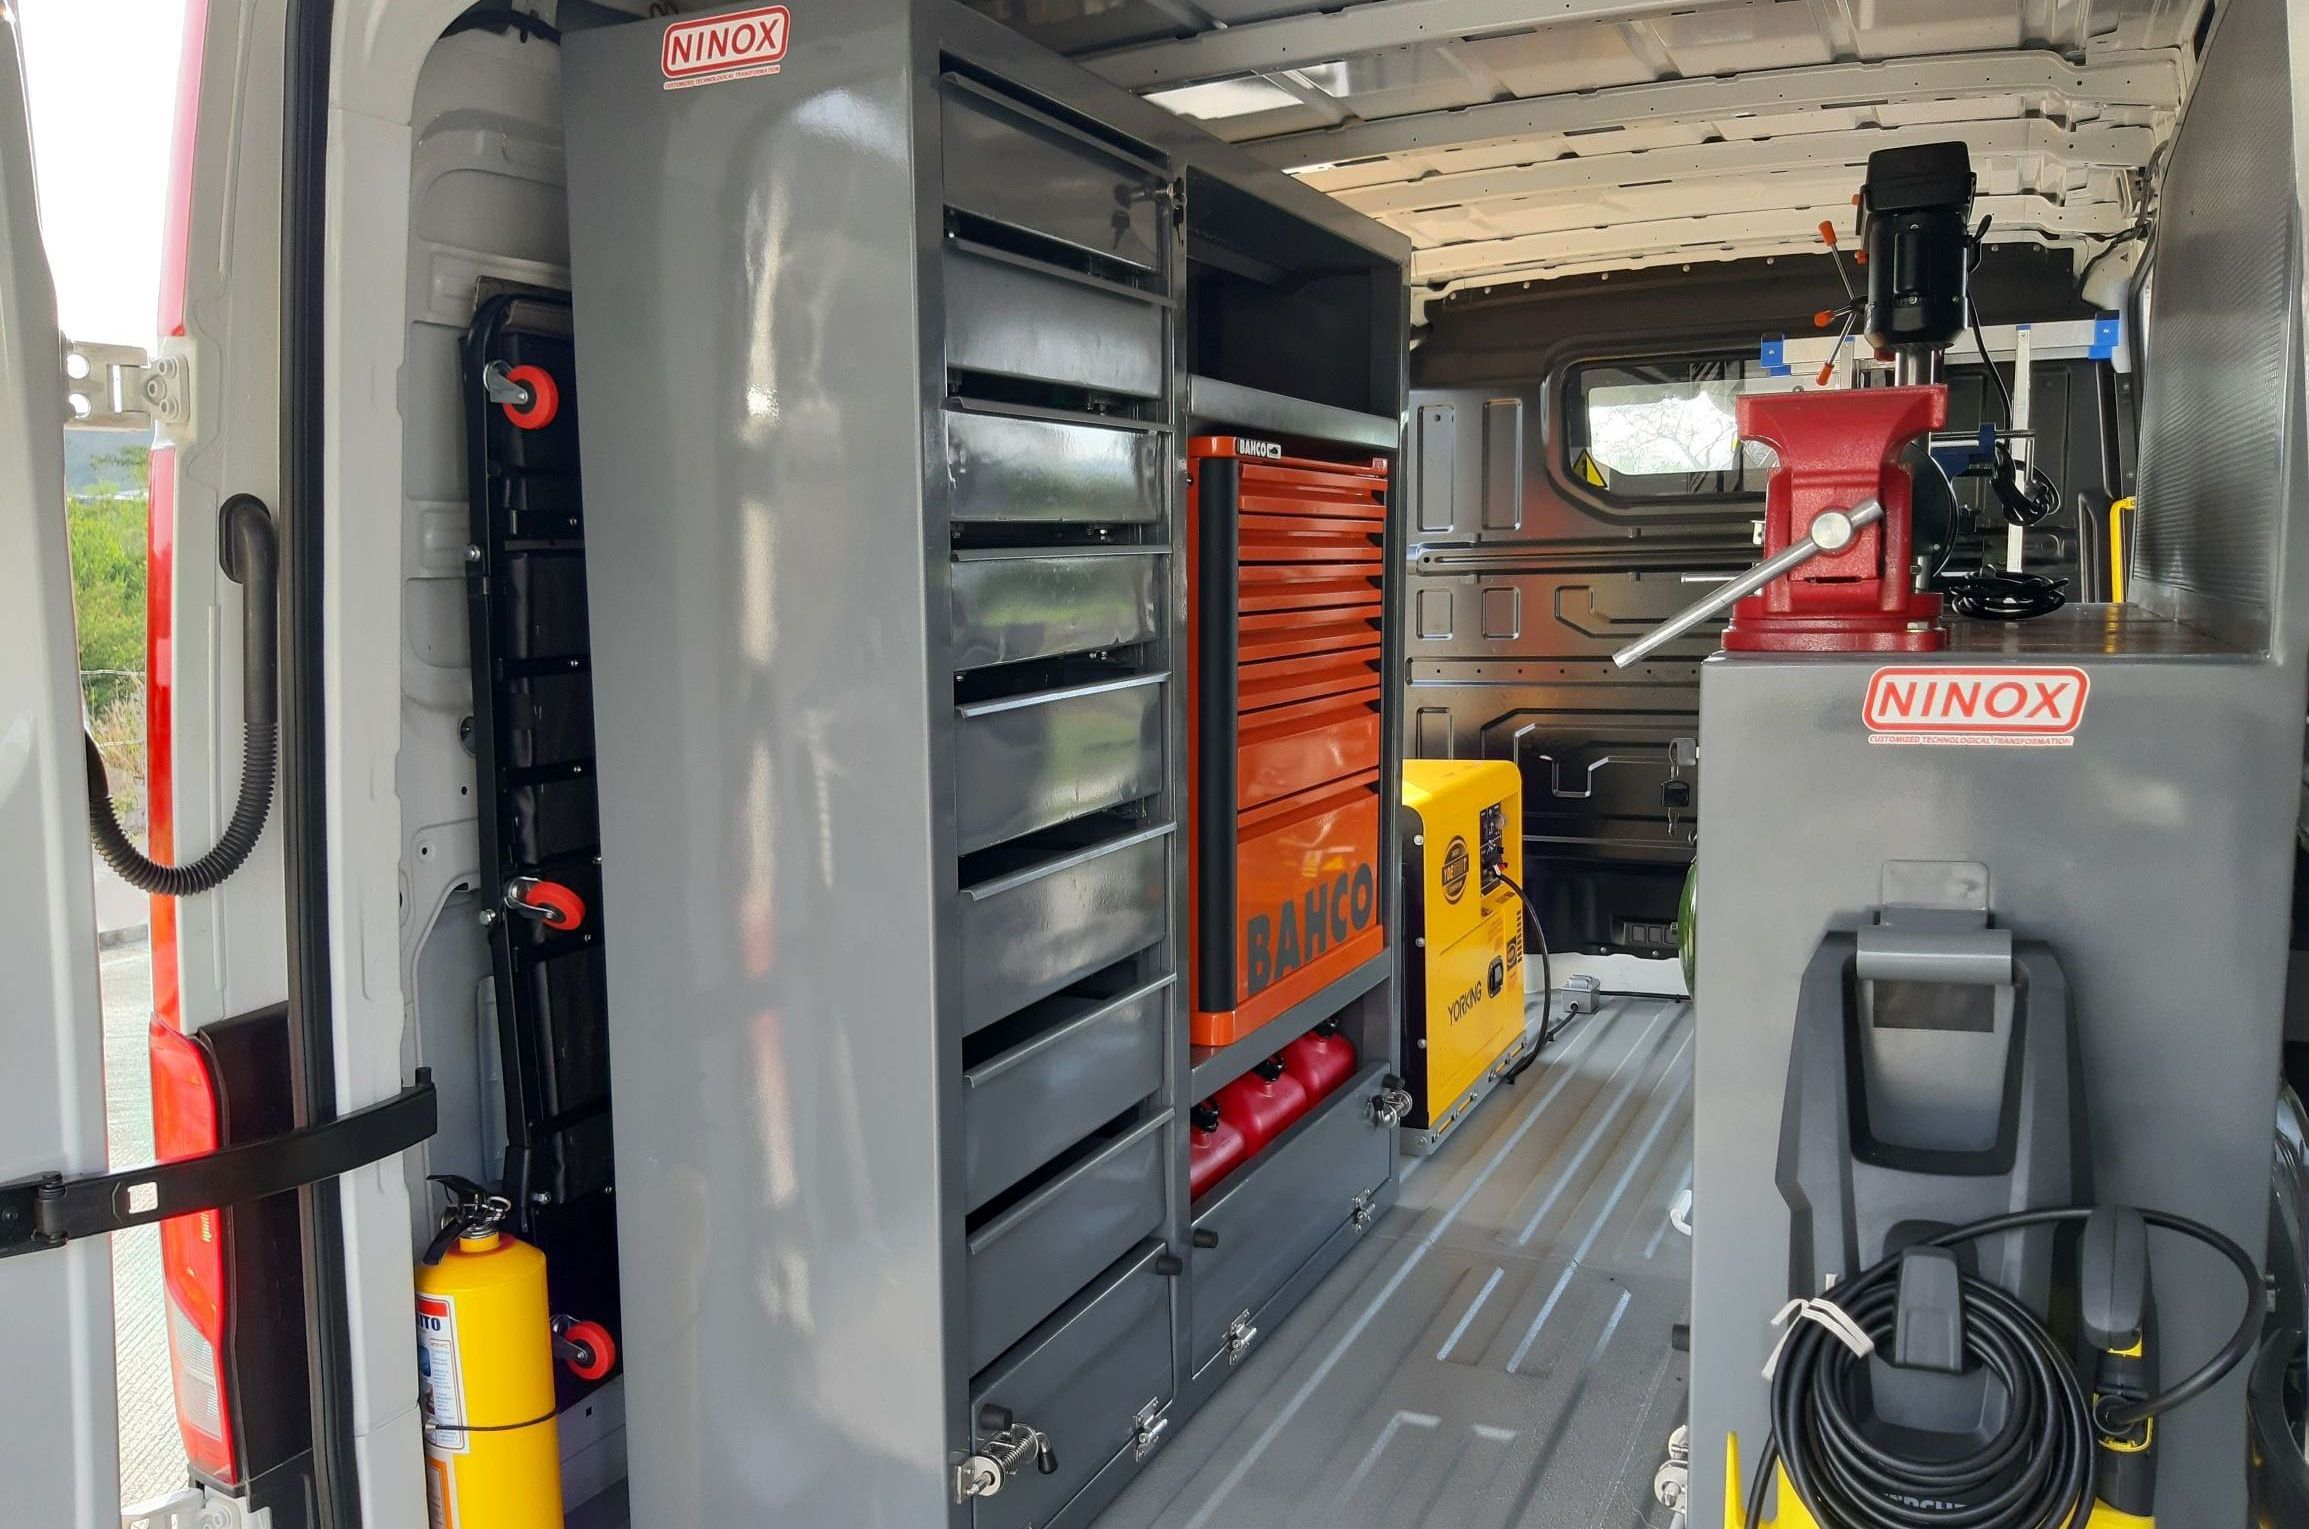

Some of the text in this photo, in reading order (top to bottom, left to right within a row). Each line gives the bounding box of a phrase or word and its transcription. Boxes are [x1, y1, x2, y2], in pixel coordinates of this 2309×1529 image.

[671, 18, 780, 66] NINOX
[1239, 438, 1267, 458] BAHCO
[1877, 681, 2071, 719] NINOX
[1869, 735, 2073, 747] CUSTOMIZED TECHNOLOGICAL TRANSFORMATION
[1247, 863, 1373, 996] BAHCO
[1448, 981, 1482, 1027] YORKING
